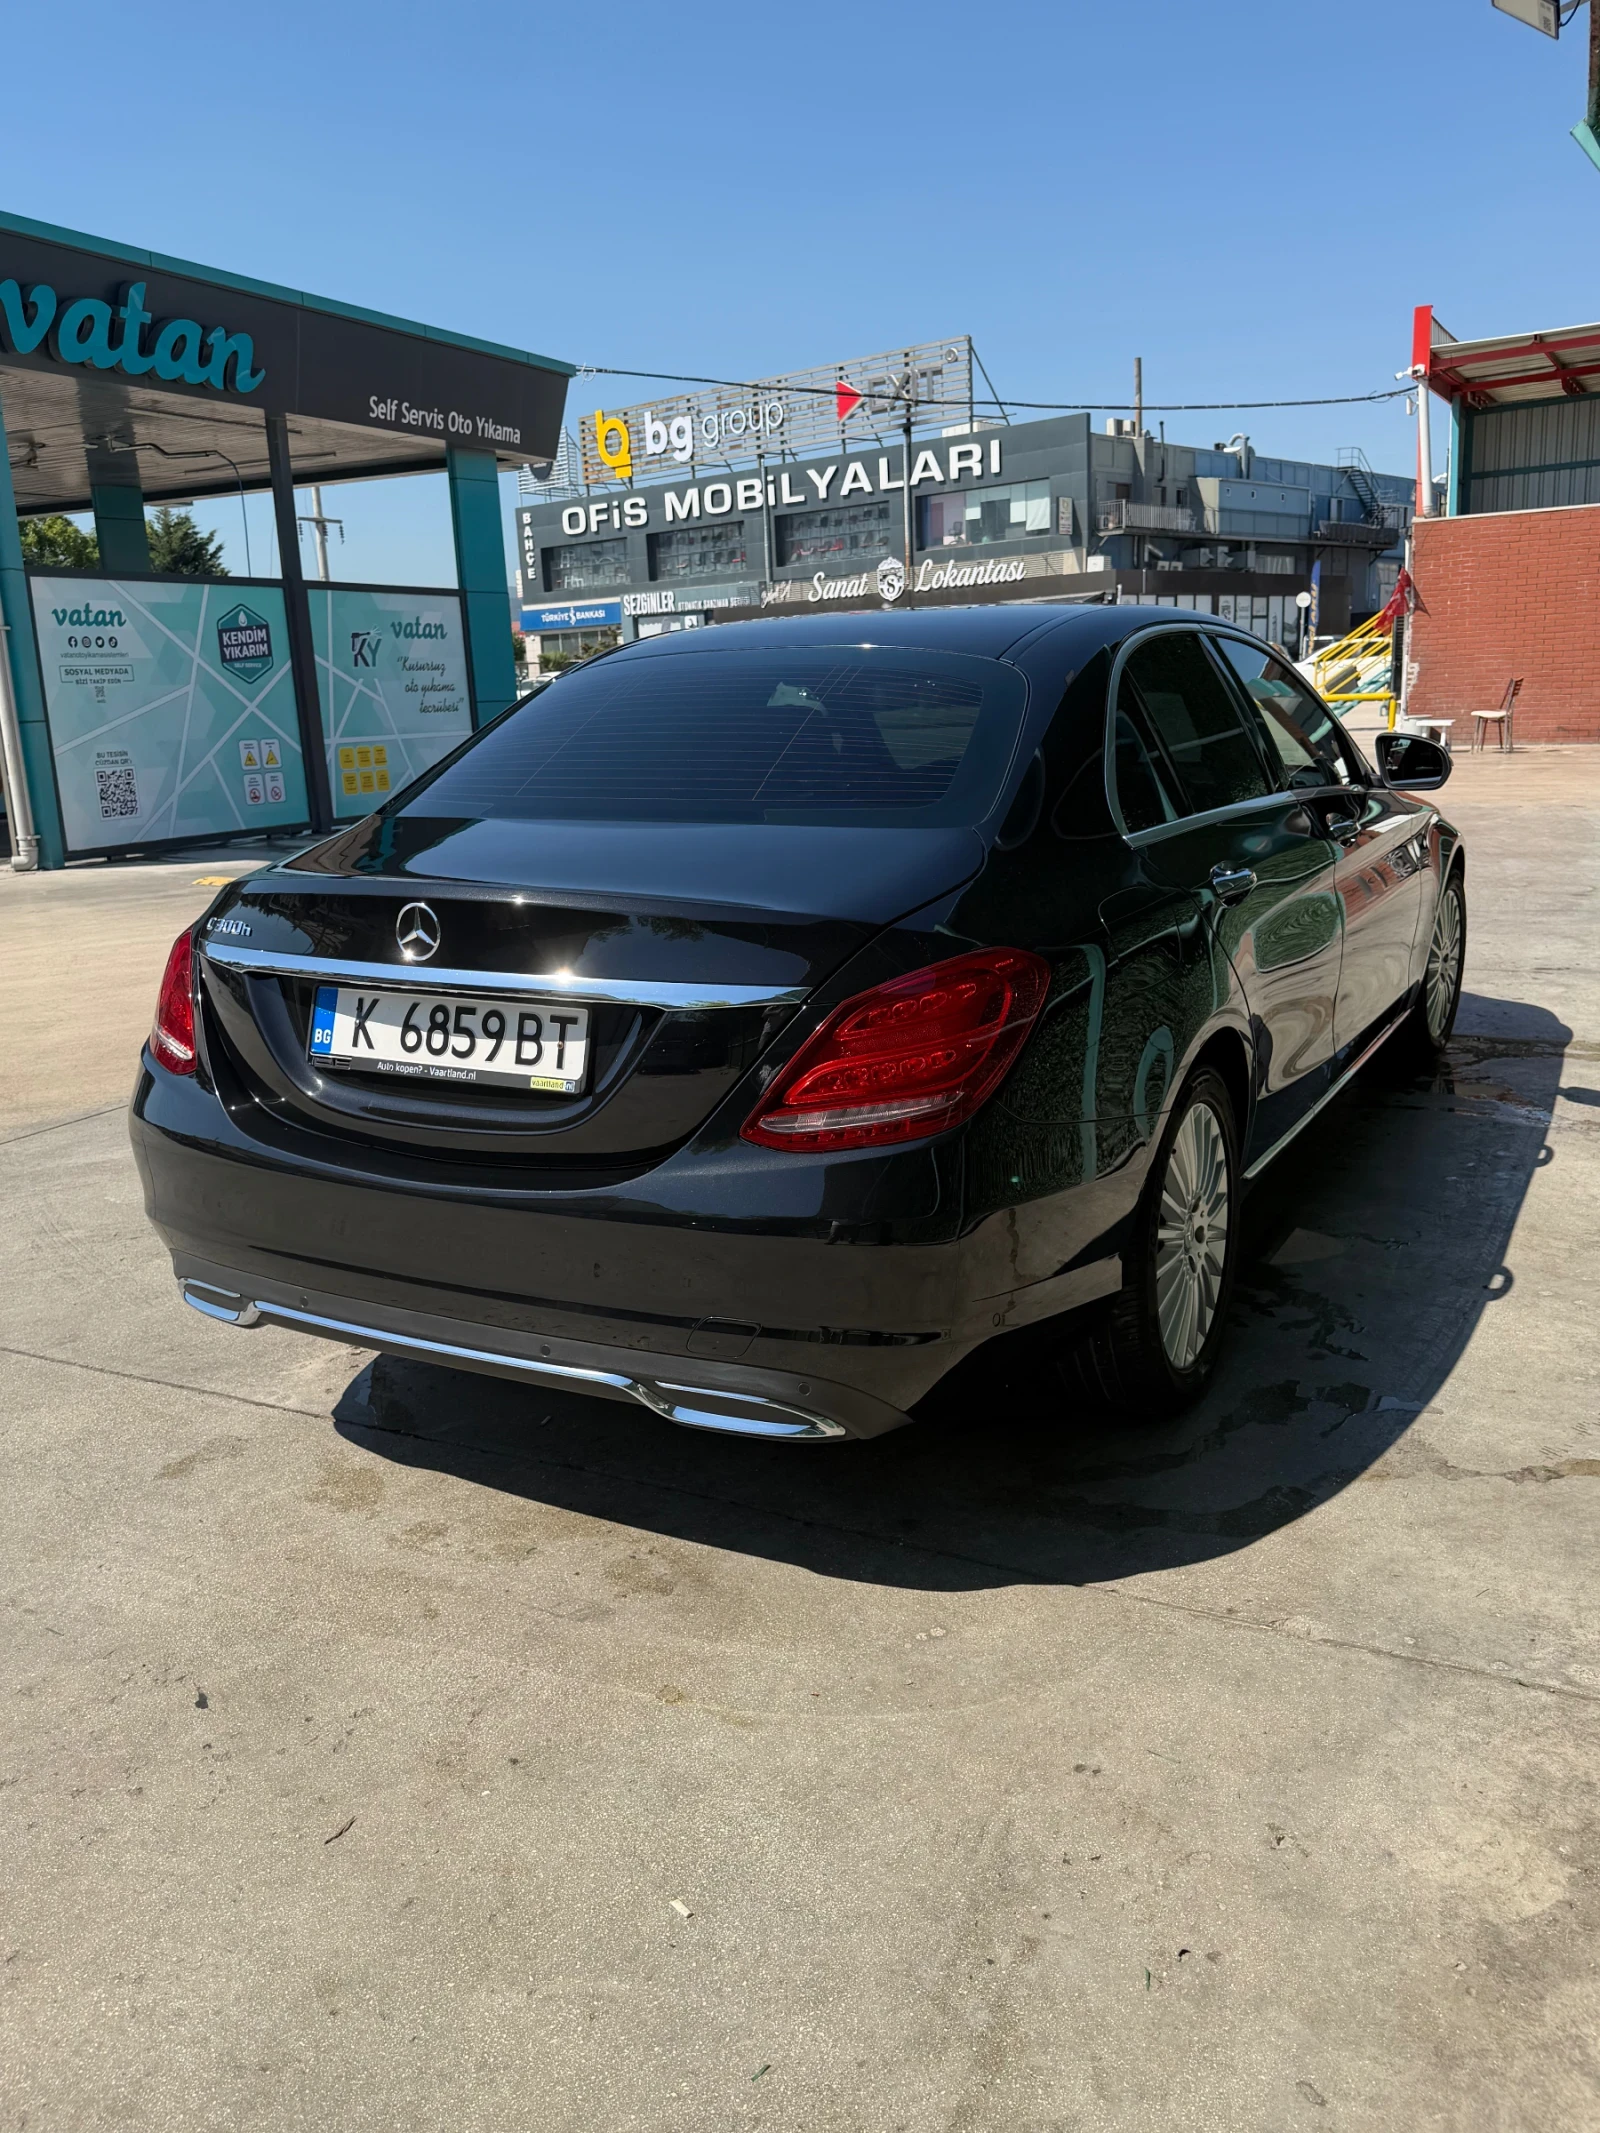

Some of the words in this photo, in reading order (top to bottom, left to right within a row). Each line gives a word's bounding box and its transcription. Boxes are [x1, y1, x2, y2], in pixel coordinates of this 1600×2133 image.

[0, 278, 266, 393] vatan
[369, 395, 399, 421] Self
[401, 402, 445, 430] Servis
[448, 411, 473, 434] Oto
[476, 416, 521, 444] Yıkama
[644, 411, 694, 462] bg
[702, 402, 784, 448] group
[522, 512, 537, 579] BAHÇE
[808, 571, 869, 602] Sanat
[913, 558, 1027, 593] Lokantası
[51, 602, 127, 627] vatan
[541, 611, 569, 622] TÜRKİYE
[575, 609, 606, 620] BANKASI
[222, 626, 267, 646] KENDİM
[390, 616, 448, 640] vatan
[223, 643, 268, 659] YIKARIM
[353, 638, 382, 667] KY
[64, 668, 93, 676] SOSYAL
[94, 667, 129, 675] MEDYADA
[405, 679, 418, 693] oto
[206, 917, 252, 937] C300h
[352, 997, 379, 1049] K
[314, 1028, 332, 1044] BG
[377, 1061, 394, 1072] Auto
[395, 1063, 423, 1075] kopen?
[429, 1066, 476, 1080] Vaartland.nl
